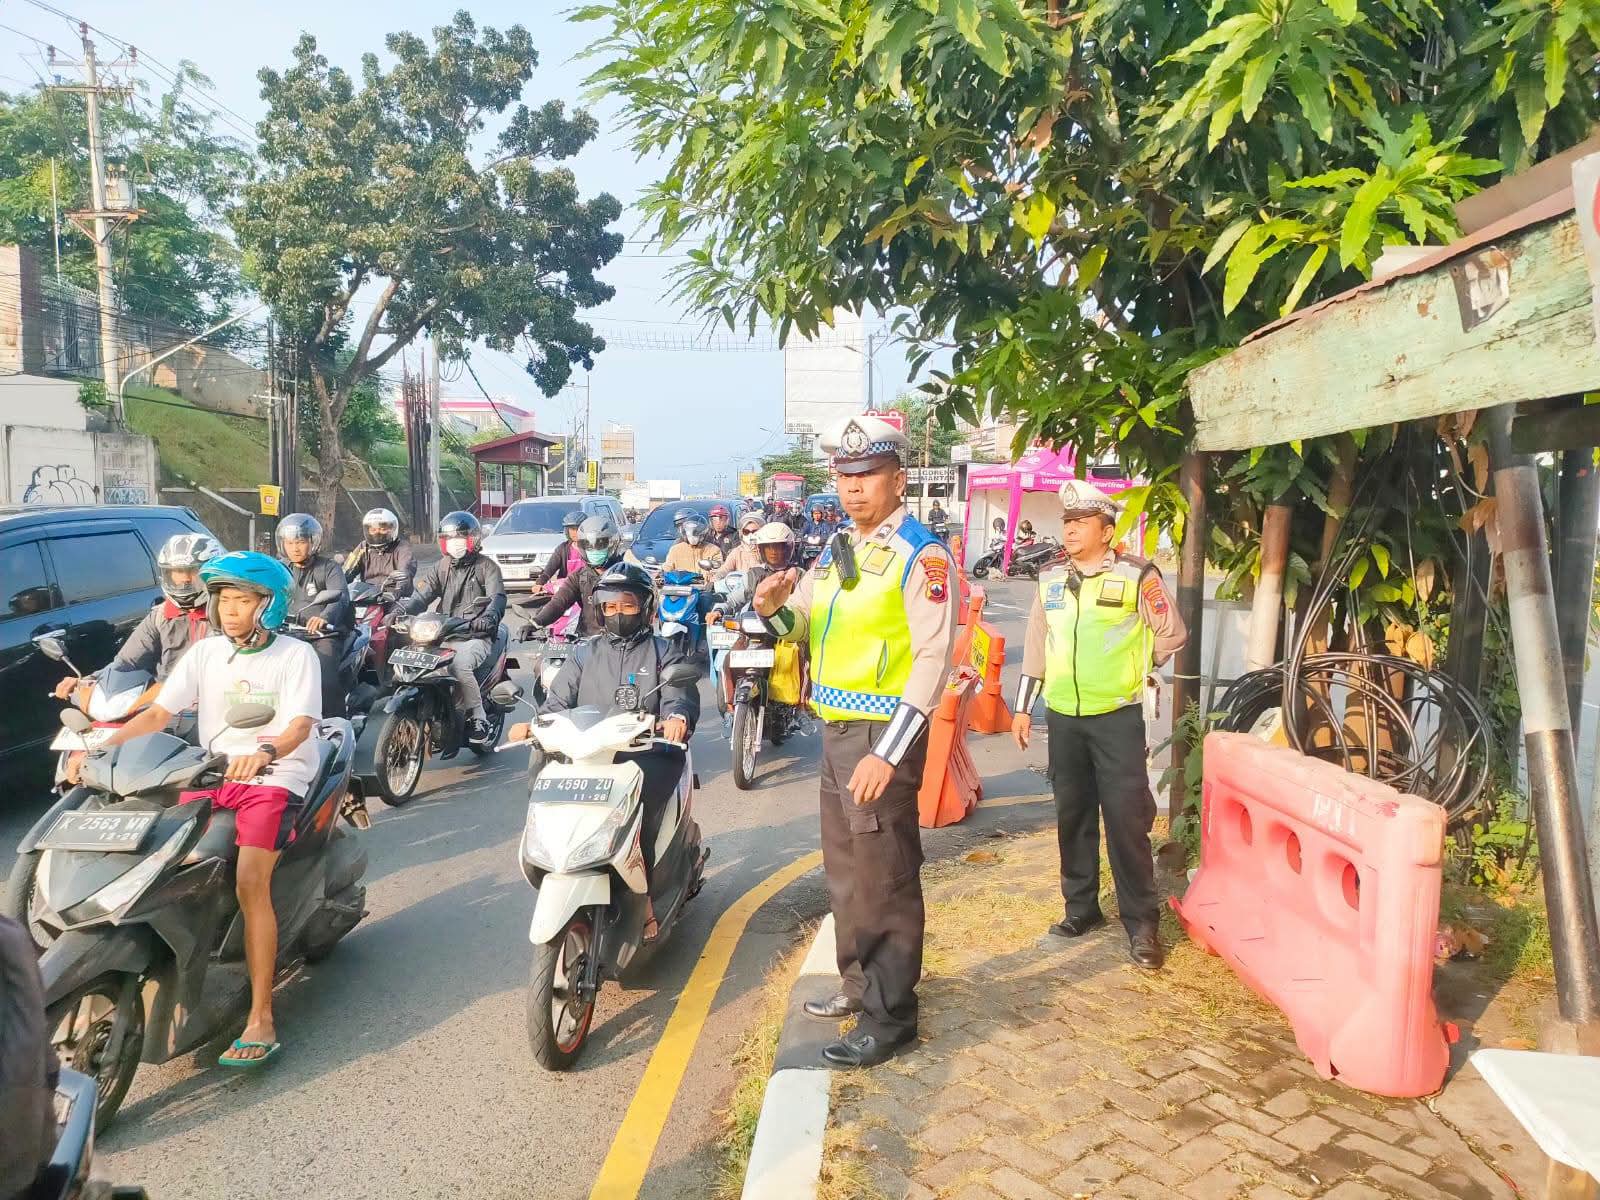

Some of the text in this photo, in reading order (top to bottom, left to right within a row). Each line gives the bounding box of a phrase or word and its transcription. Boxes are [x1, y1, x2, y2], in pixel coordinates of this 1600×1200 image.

[533, 779, 613, 791] AB 4590 ZU
[60, 817, 77, 830] K
[78, 817, 122, 831] 2563
